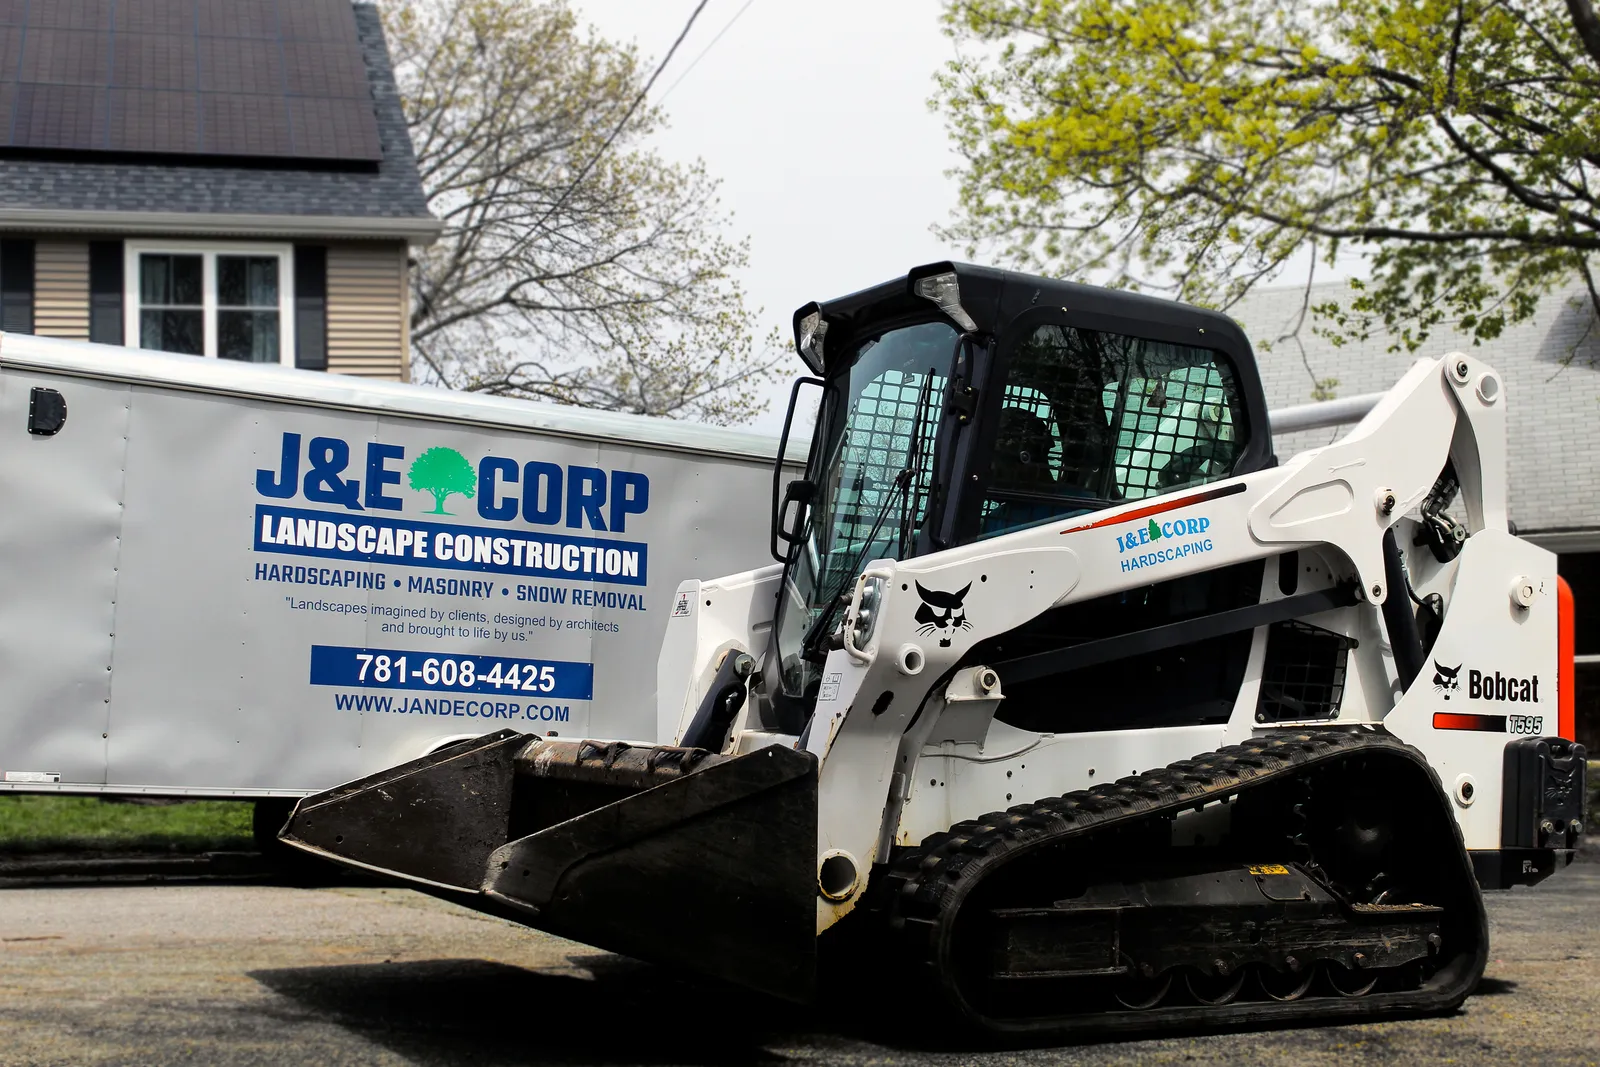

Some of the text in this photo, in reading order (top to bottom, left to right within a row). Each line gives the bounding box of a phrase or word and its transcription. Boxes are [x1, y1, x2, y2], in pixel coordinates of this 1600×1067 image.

[256, 432, 649, 533] J&E CORP
[261, 515, 639, 577] LANDSCAPE CONSTRUCTION
[1116, 517, 1210, 553] J&E CORP
[1121, 539, 1213, 573] HARDSCAPING
[255, 563, 647, 611] HARDSCAPING MASONRY SNOW REMOVAL
[286, 597, 619, 632] "Landscapes imagined by clients, designed by architects
[381, 622, 533, 642] and brought to life by us."
[356, 654, 555, 692] 781-608-4425
[1468, 669, 1539, 703] Bobcat
[335, 694, 570, 722] WWW.JANDECORP.COM
[1509, 714, 1543, 735] T595
